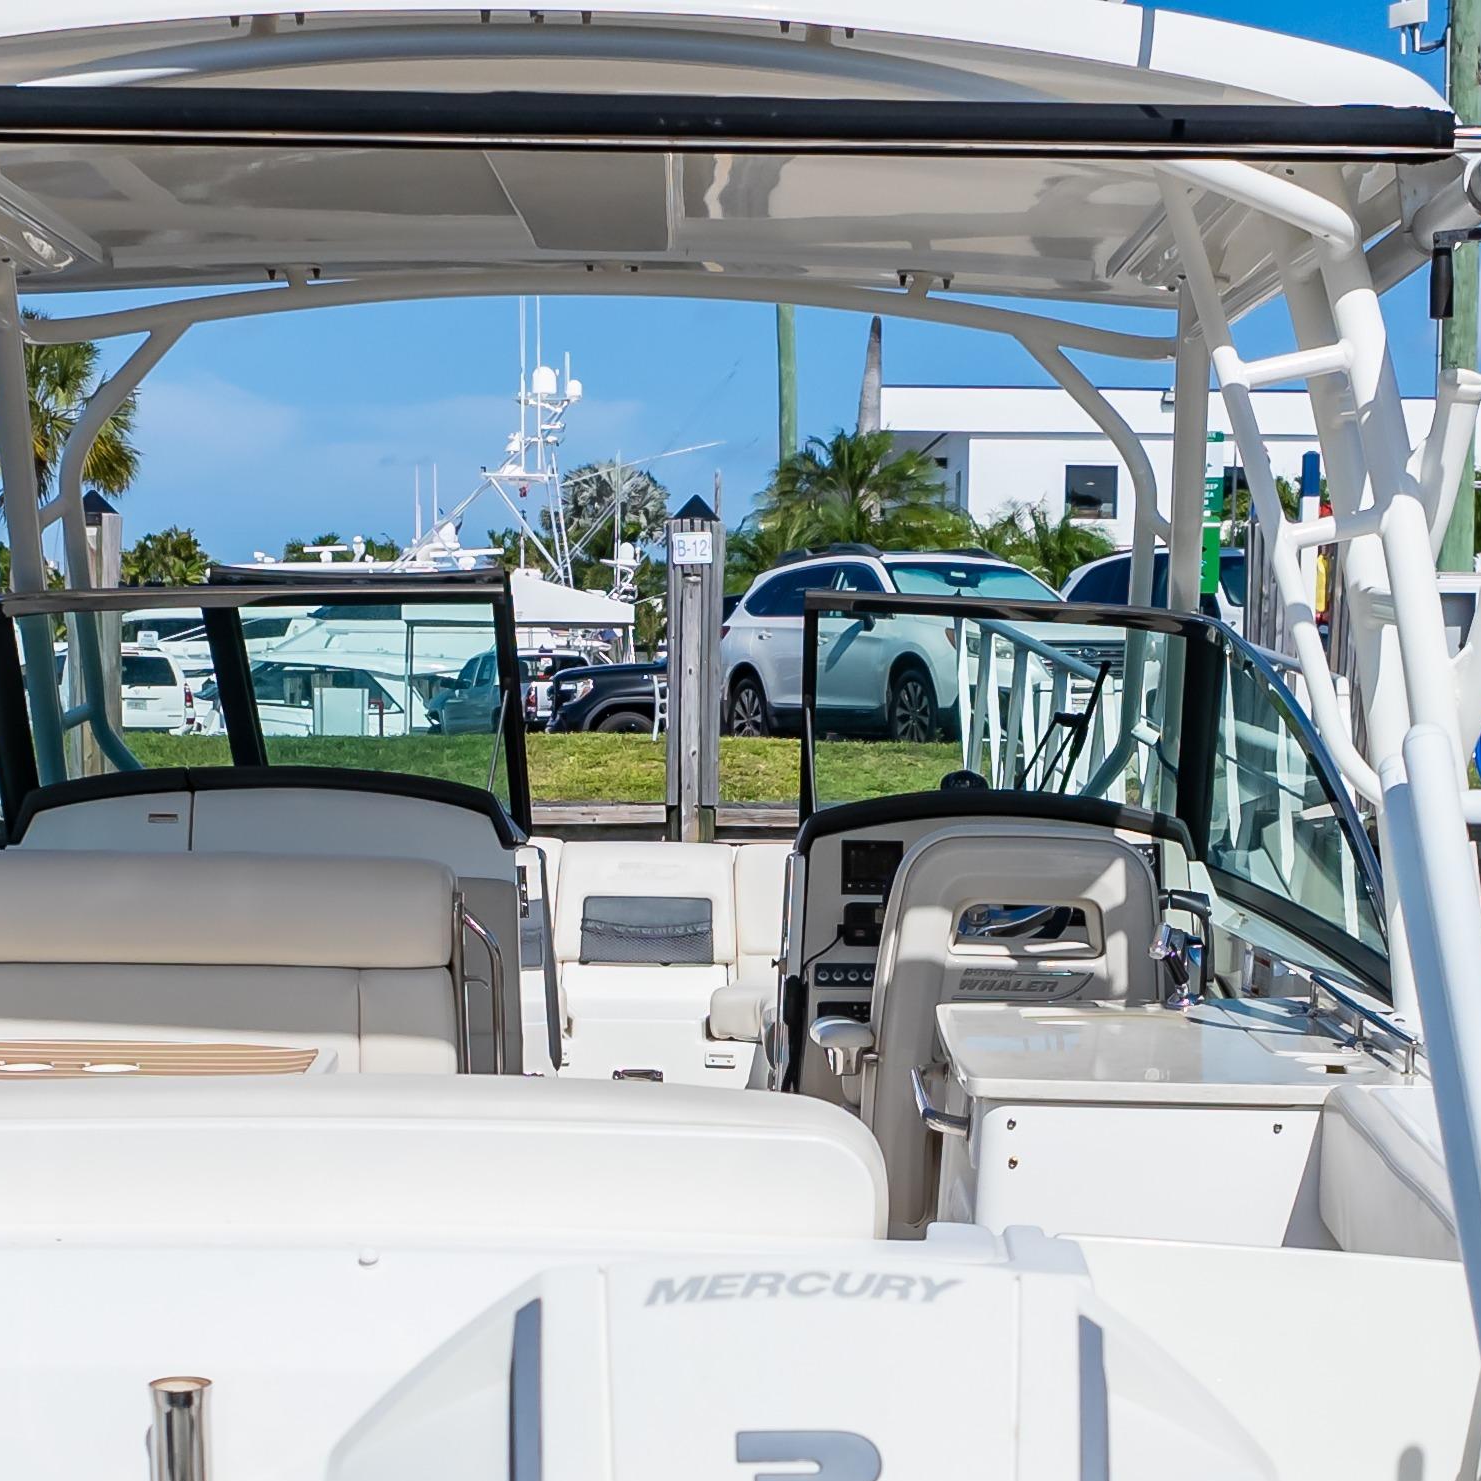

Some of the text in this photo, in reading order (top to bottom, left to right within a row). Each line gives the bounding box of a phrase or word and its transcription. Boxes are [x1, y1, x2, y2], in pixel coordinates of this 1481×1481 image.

[678, 539, 708, 557] B-12
[959, 978, 1059, 992] WHALER
[643, 1271, 964, 1306] MERCURY
